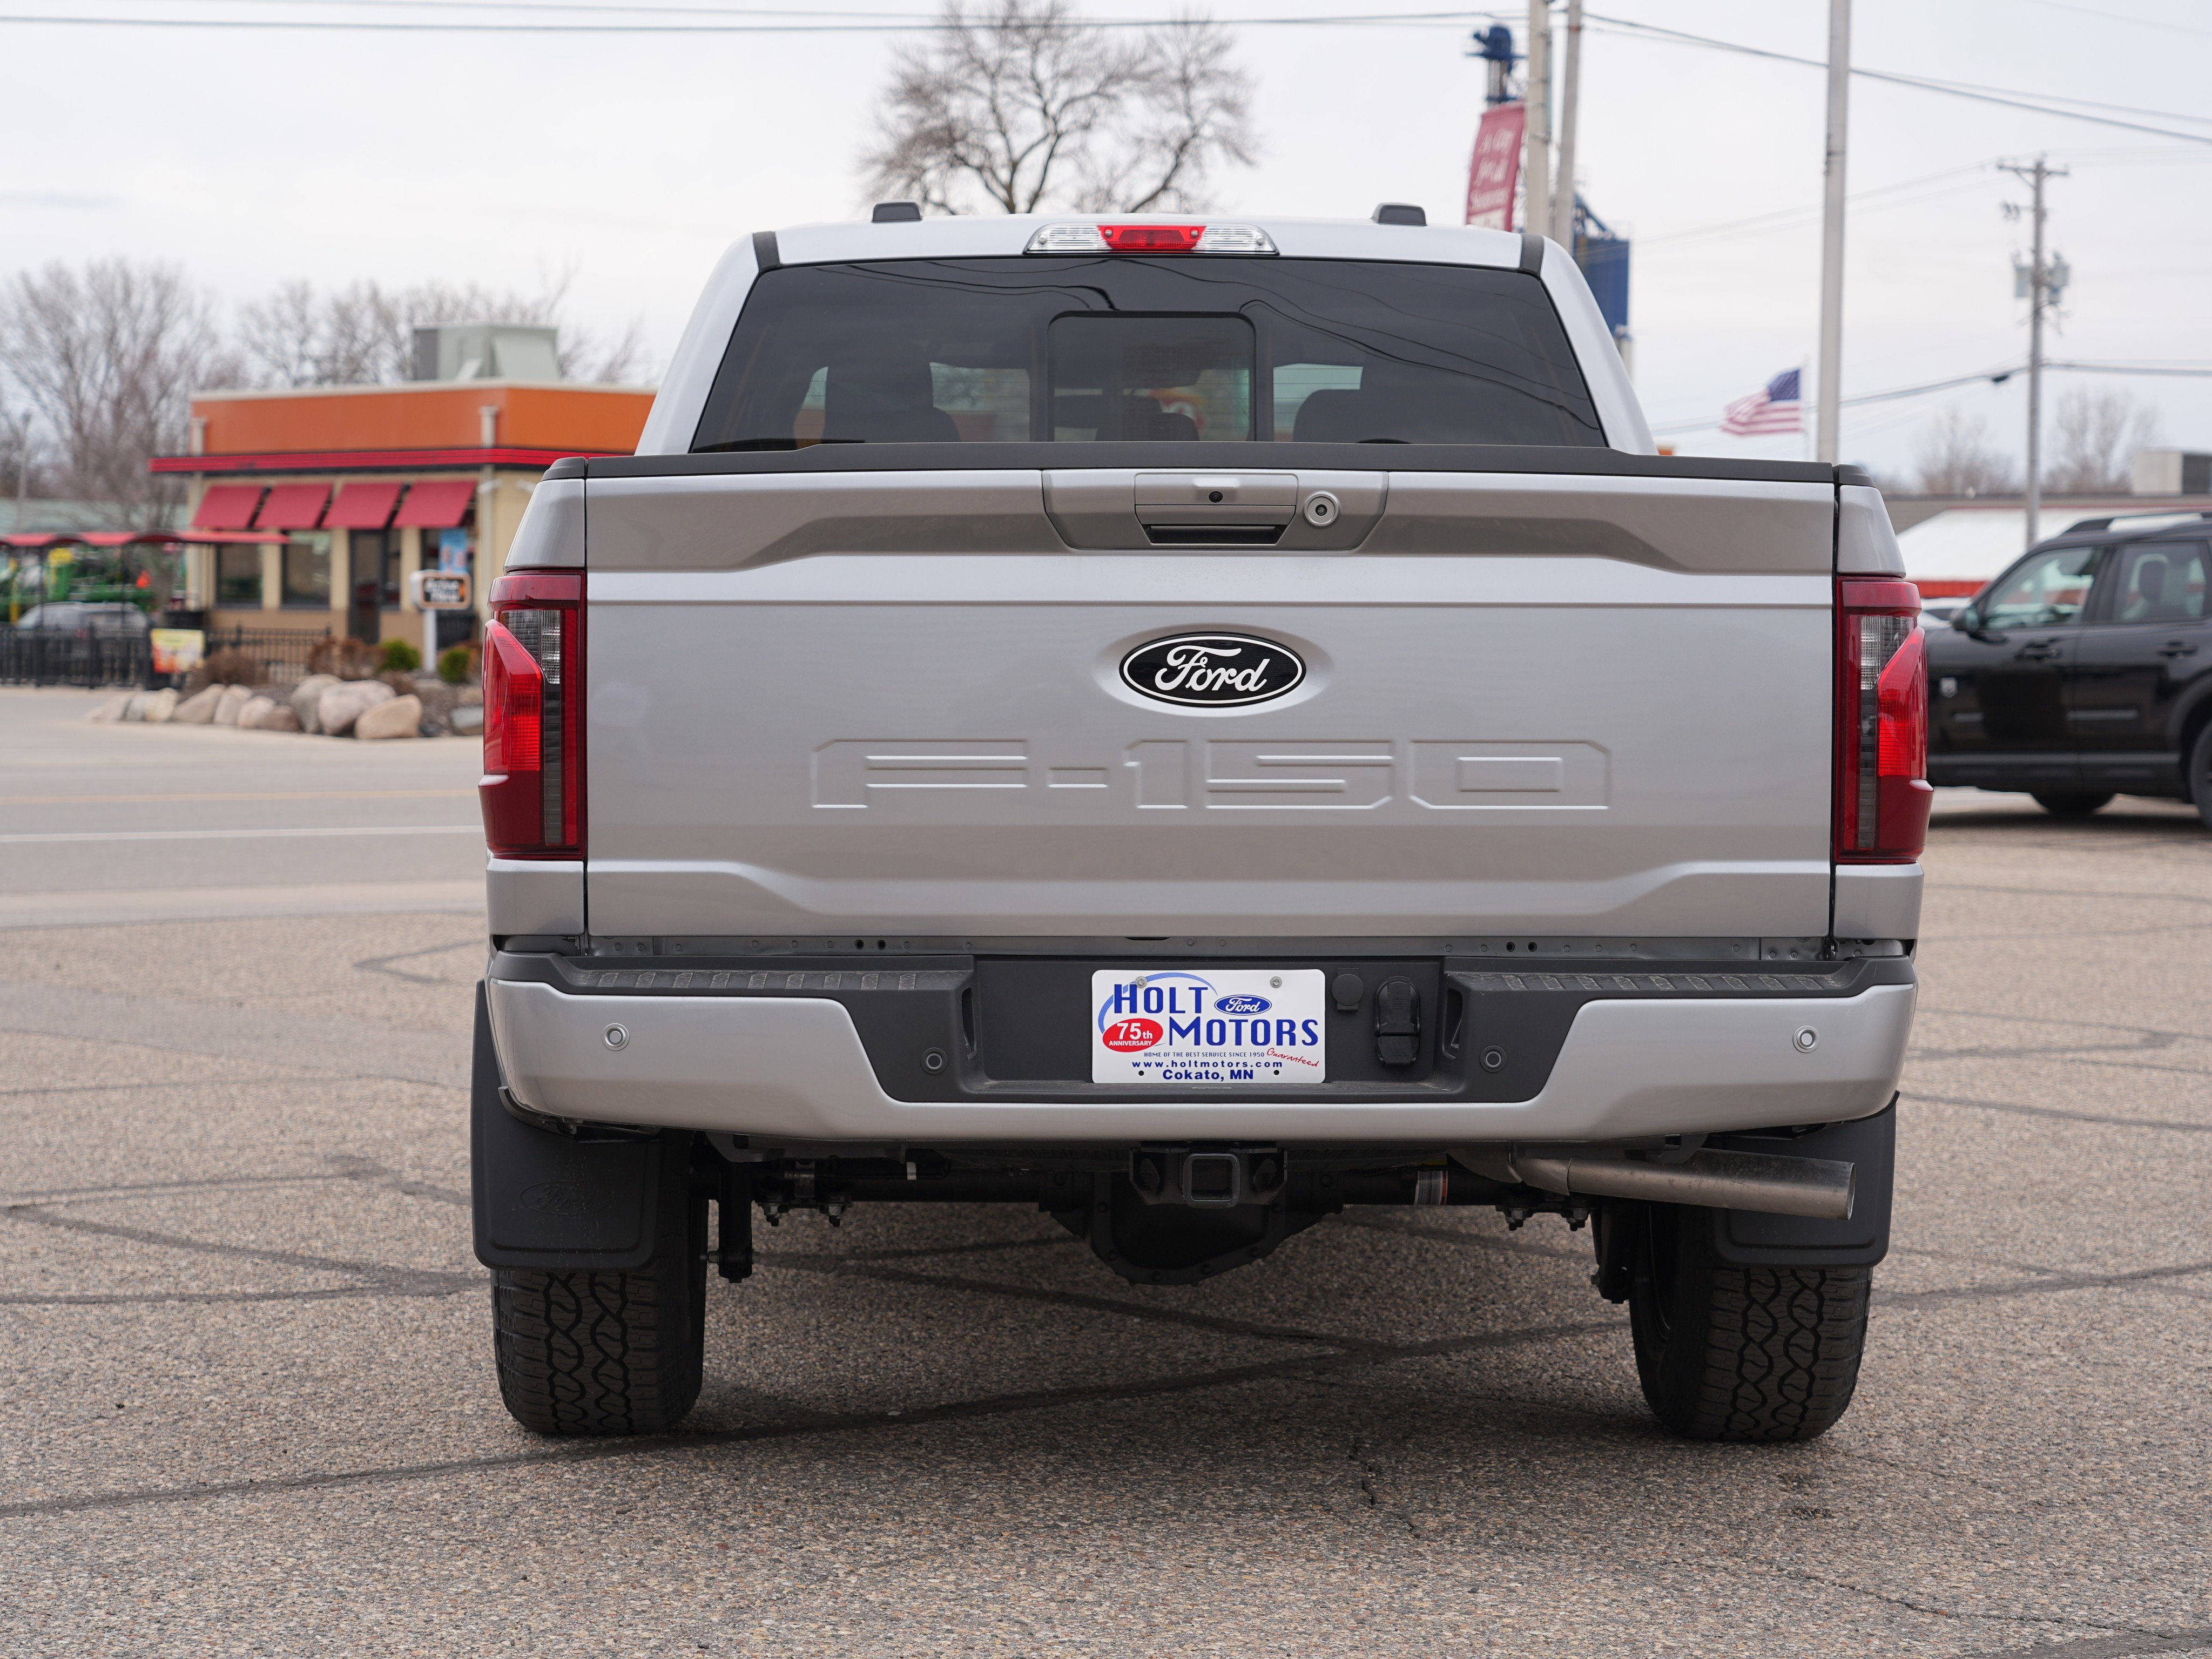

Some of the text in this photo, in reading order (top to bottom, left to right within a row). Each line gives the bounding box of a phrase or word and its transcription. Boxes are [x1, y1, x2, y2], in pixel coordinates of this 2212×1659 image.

[1155, 645, 1270, 692] Ford
[810, 739, 1611, 810] F-150
[1114, 984, 1208, 1014] HOLT
[1225, 996, 1260, 1013] Ford
[1116, 1022, 1153, 1040] 75th
[1169, 1016, 1319, 1046] MOTORS
[1132, 1060, 1283, 1068] www.holtmotors.com
[1266, 1047, 1319, 1067] Guaranteed
[1162, 1069, 1253, 1082] Cokato, MN
